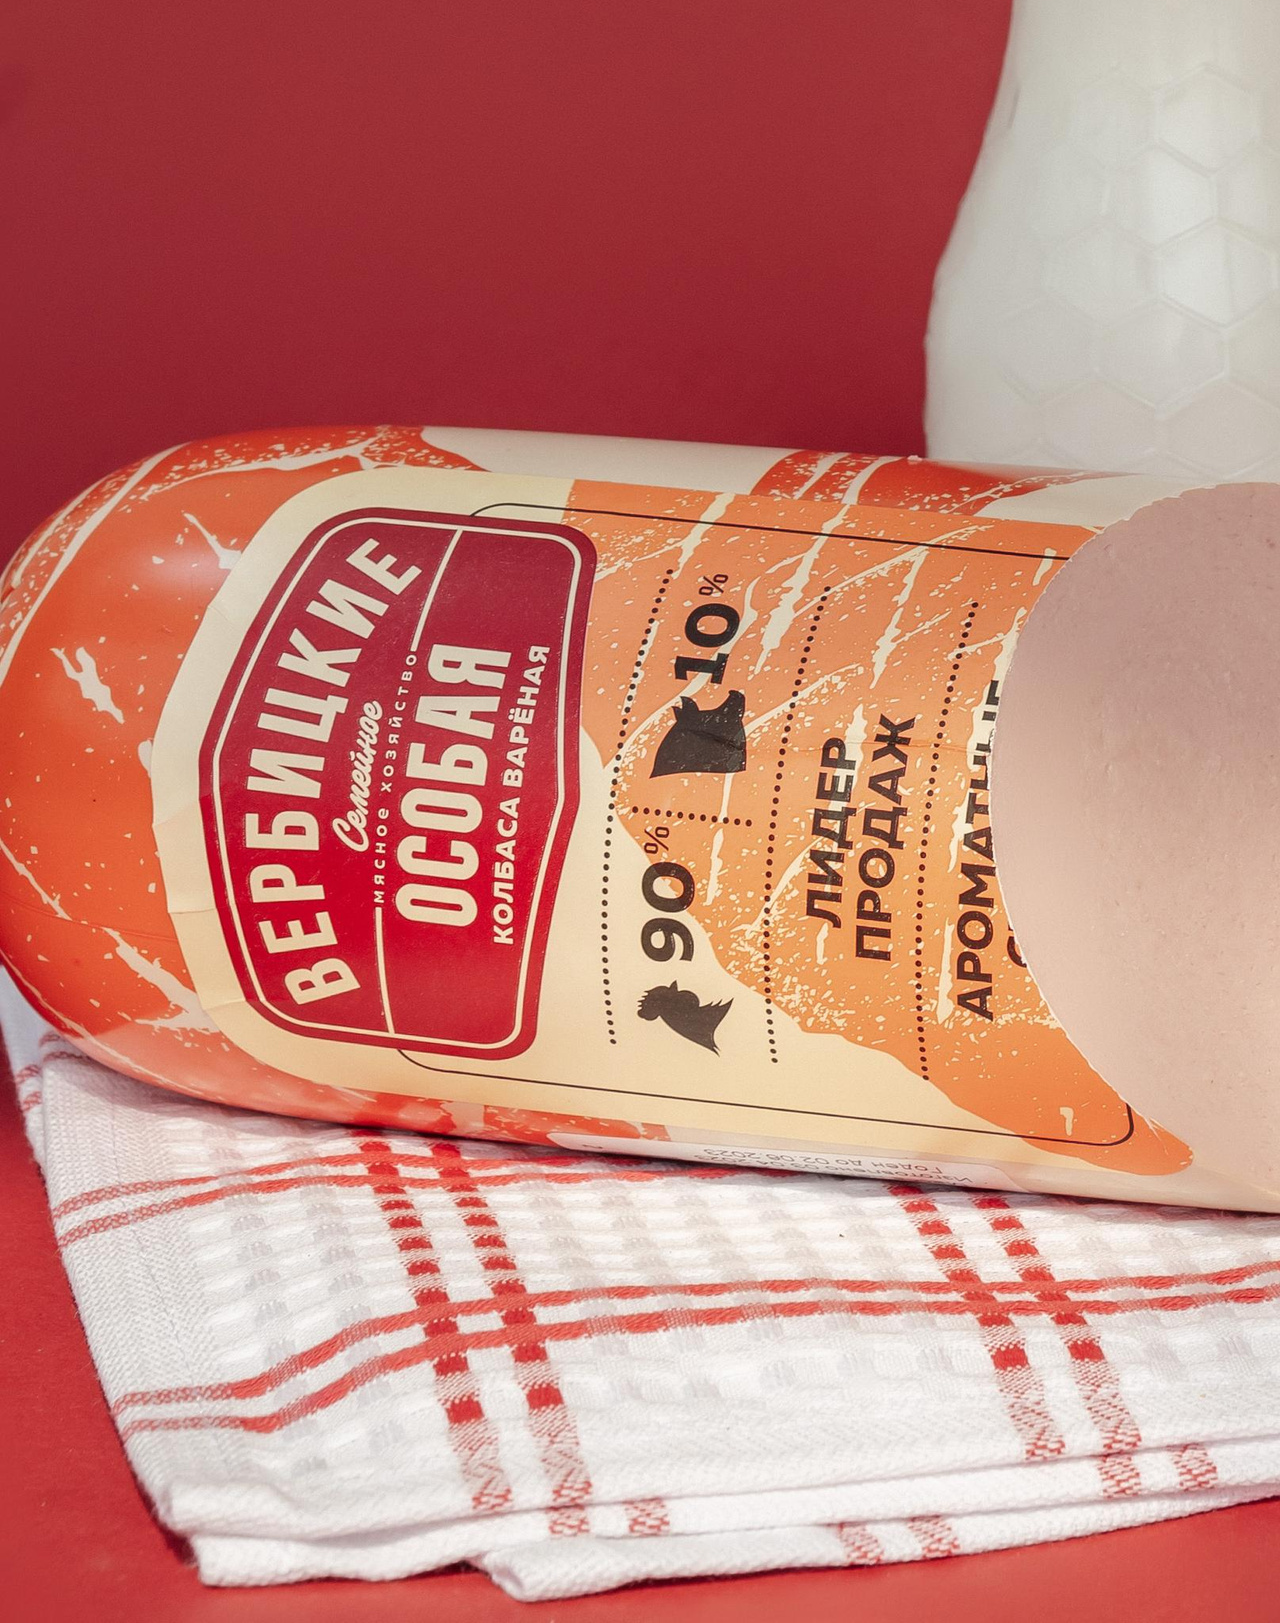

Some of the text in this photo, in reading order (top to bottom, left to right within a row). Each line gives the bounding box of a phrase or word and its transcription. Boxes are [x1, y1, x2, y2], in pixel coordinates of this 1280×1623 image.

[245, 537, 422, 1005] ВЕРБИЦКИЕ
[332, 699, 384, 852] Семейное
[395, 643, 512, 928] ОСОБАЯ
[492, 645, 551, 946] КОЛБАСА ВАРЁНАЯ
[806, 736, 858, 929] ЛИДЕР
[855, 713, 916, 962] ПРОДАЖ
